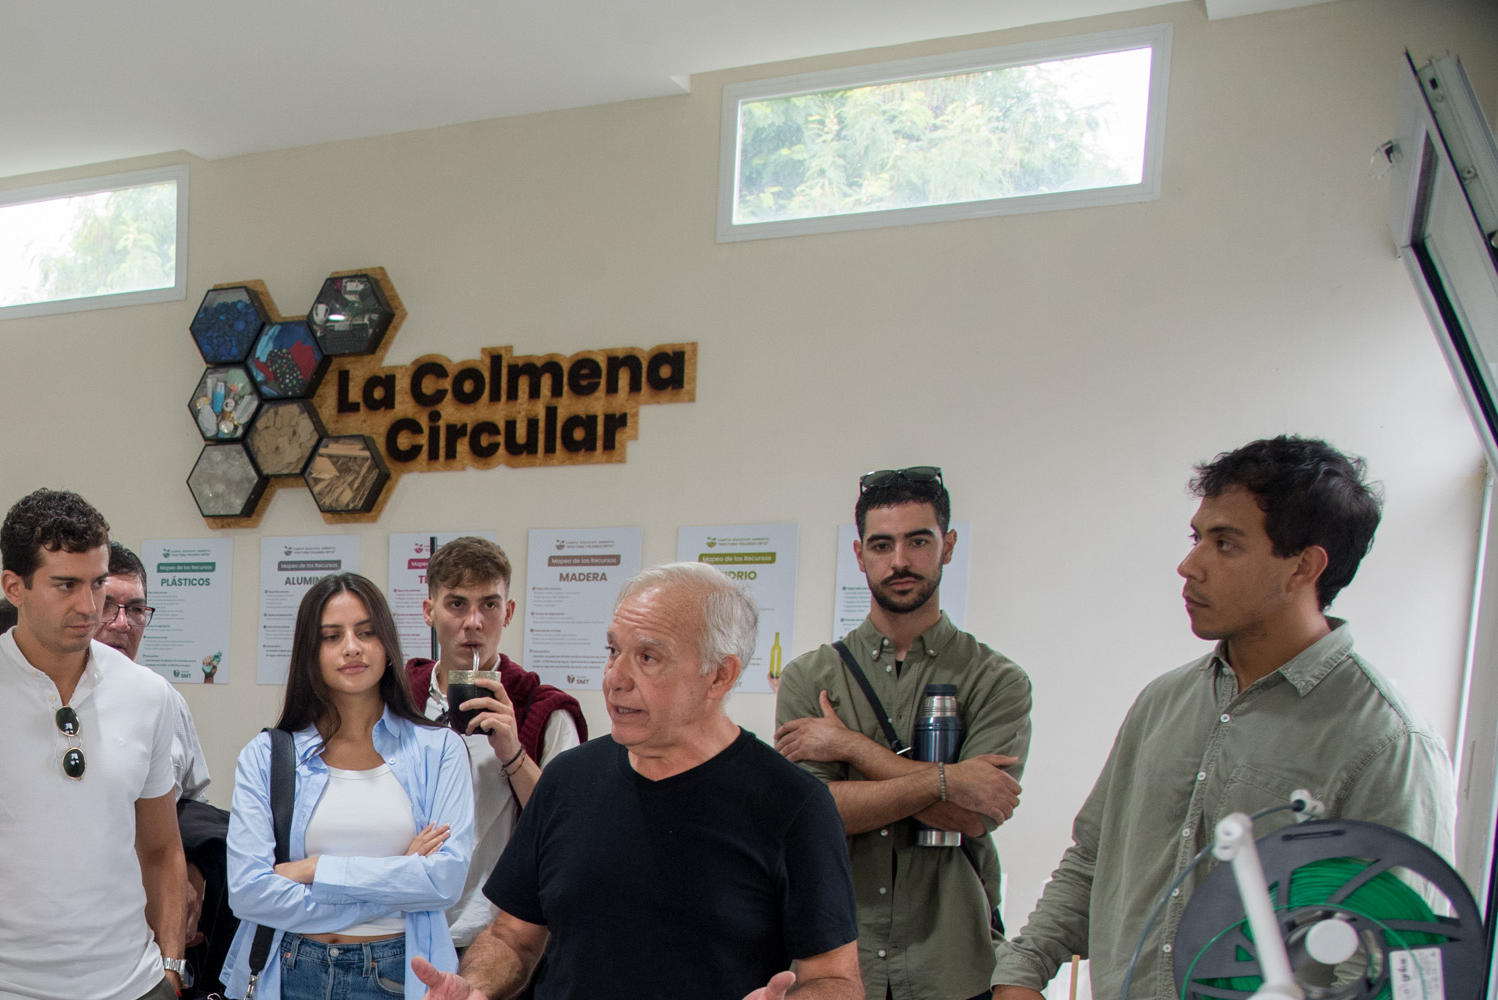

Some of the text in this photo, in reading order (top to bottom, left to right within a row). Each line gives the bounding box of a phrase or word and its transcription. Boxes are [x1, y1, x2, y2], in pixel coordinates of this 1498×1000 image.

[338, 351, 685, 413] La Colmena
[386, 405, 627, 462] Circular
[160, 575, 211, 587] PLÁSTICOS
[284, 576, 323, 586] ALUMIN
[559, 572, 608, 582] MADERA
